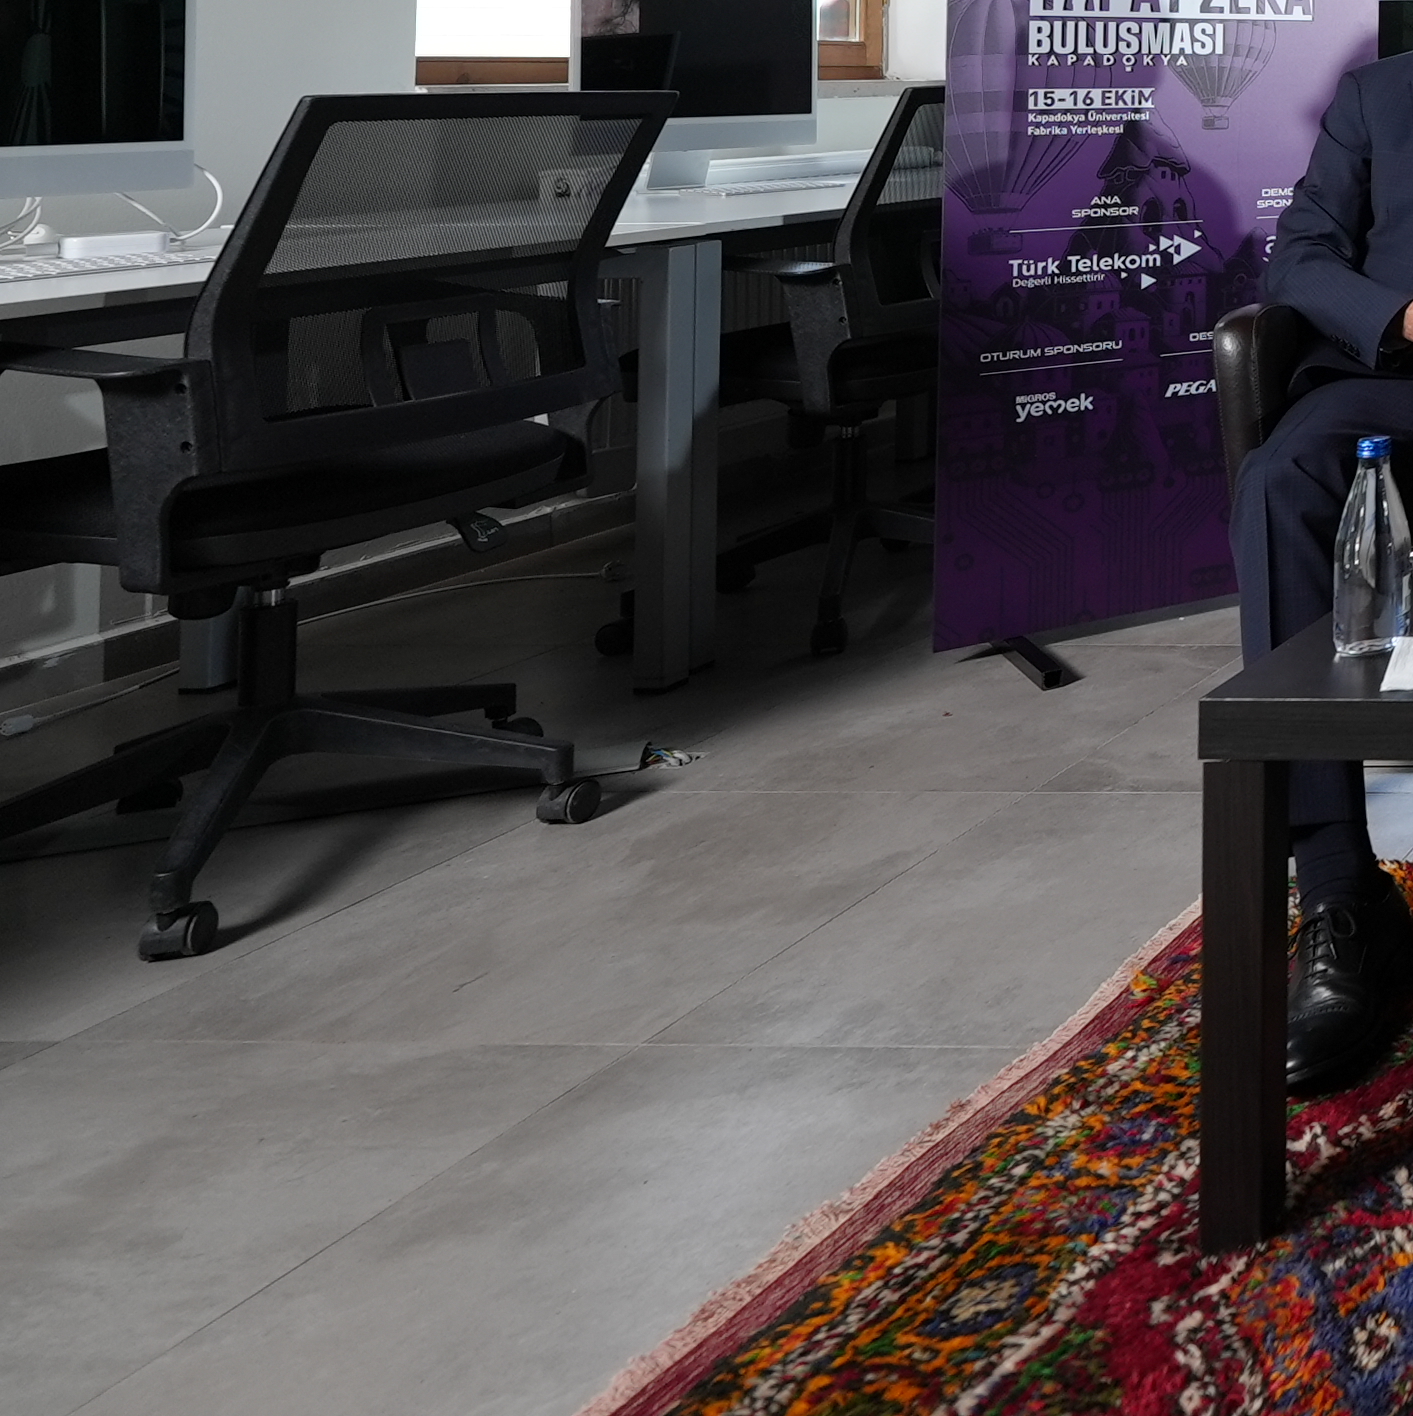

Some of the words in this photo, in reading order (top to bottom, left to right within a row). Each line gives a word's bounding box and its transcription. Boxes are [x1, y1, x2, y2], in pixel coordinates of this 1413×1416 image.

[1028, 54, 1189, 67] KAPADOKYA
[1029, 90, 1095, 108] 15-16
[1028, 113, 1085, 125] Kapadokya
[1087, 110, 1150, 122] Üniversitesi
[1028, 126, 1068, 136] Fabrika
[1091, 195, 1121, 205] ANA
[1256, 198, 1294, 209] SPON
[1072, 206, 1139, 218] SPONSOR
[1009, 257, 1061, 277] Türk
[1067, 252, 1161, 274] Telekom
[980, 347, 1042, 363] OTURUM
[1044, 340, 1123, 356] SPONSORU
[1164, 379, 1217, 398] PEGA
[1016, 392, 1094, 423] yemek
